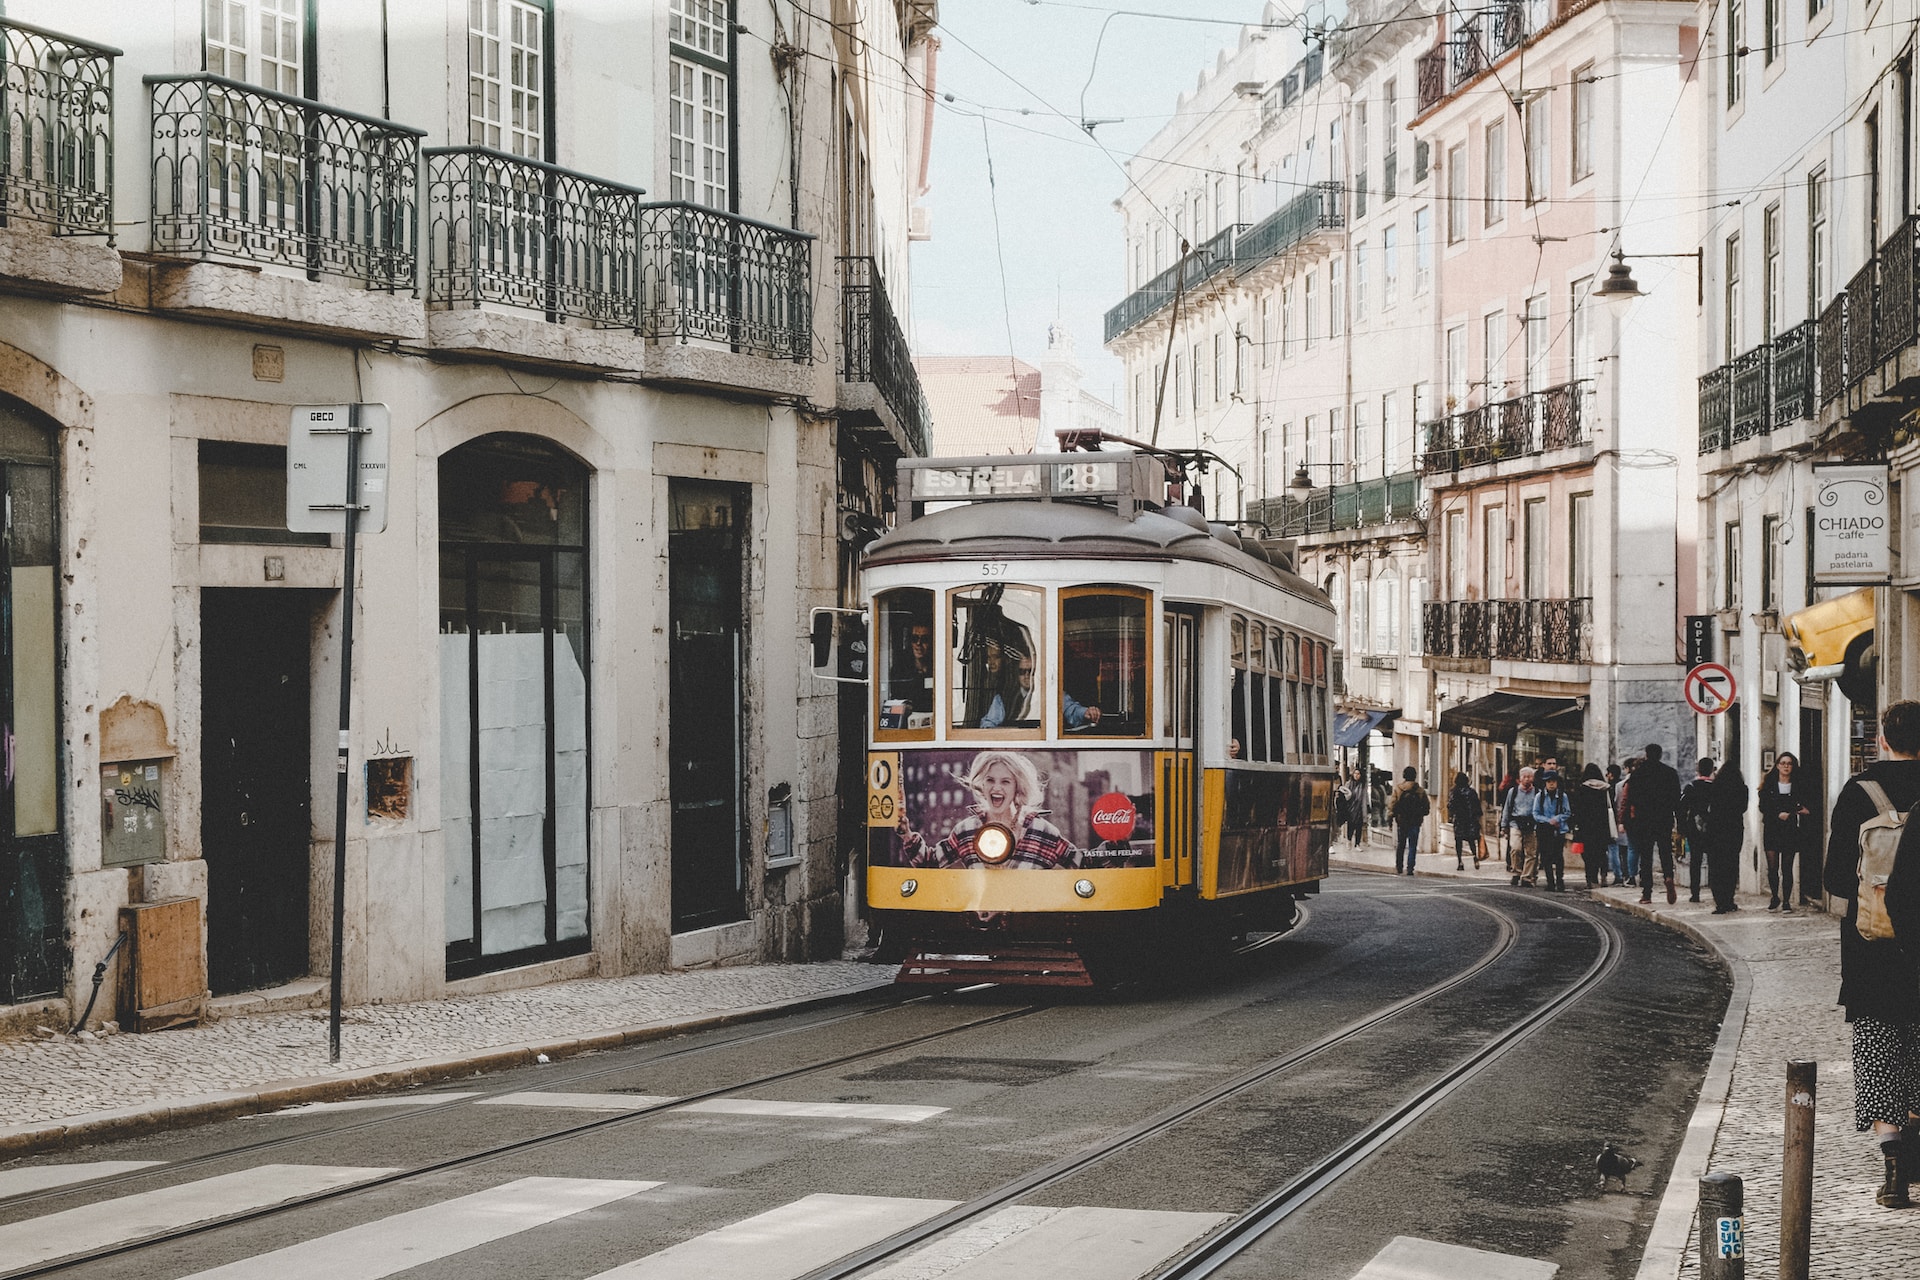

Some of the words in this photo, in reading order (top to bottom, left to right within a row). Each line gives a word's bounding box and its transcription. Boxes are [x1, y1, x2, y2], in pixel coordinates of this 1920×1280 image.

[925, 469, 1036, 488] ESTRELA
[1060, 465, 1101, 489] 28
[1819, 516, 1884, 531] CHIADO
[1834, 551, 1868, 560] padaria
[982, 563, 1008, 576] 557
[1830, 560, 1873, 570] pastelaria
[1093, 809, 1133, 825] Coca-Cola
[1118, 849, 1143, 857] FEELING
